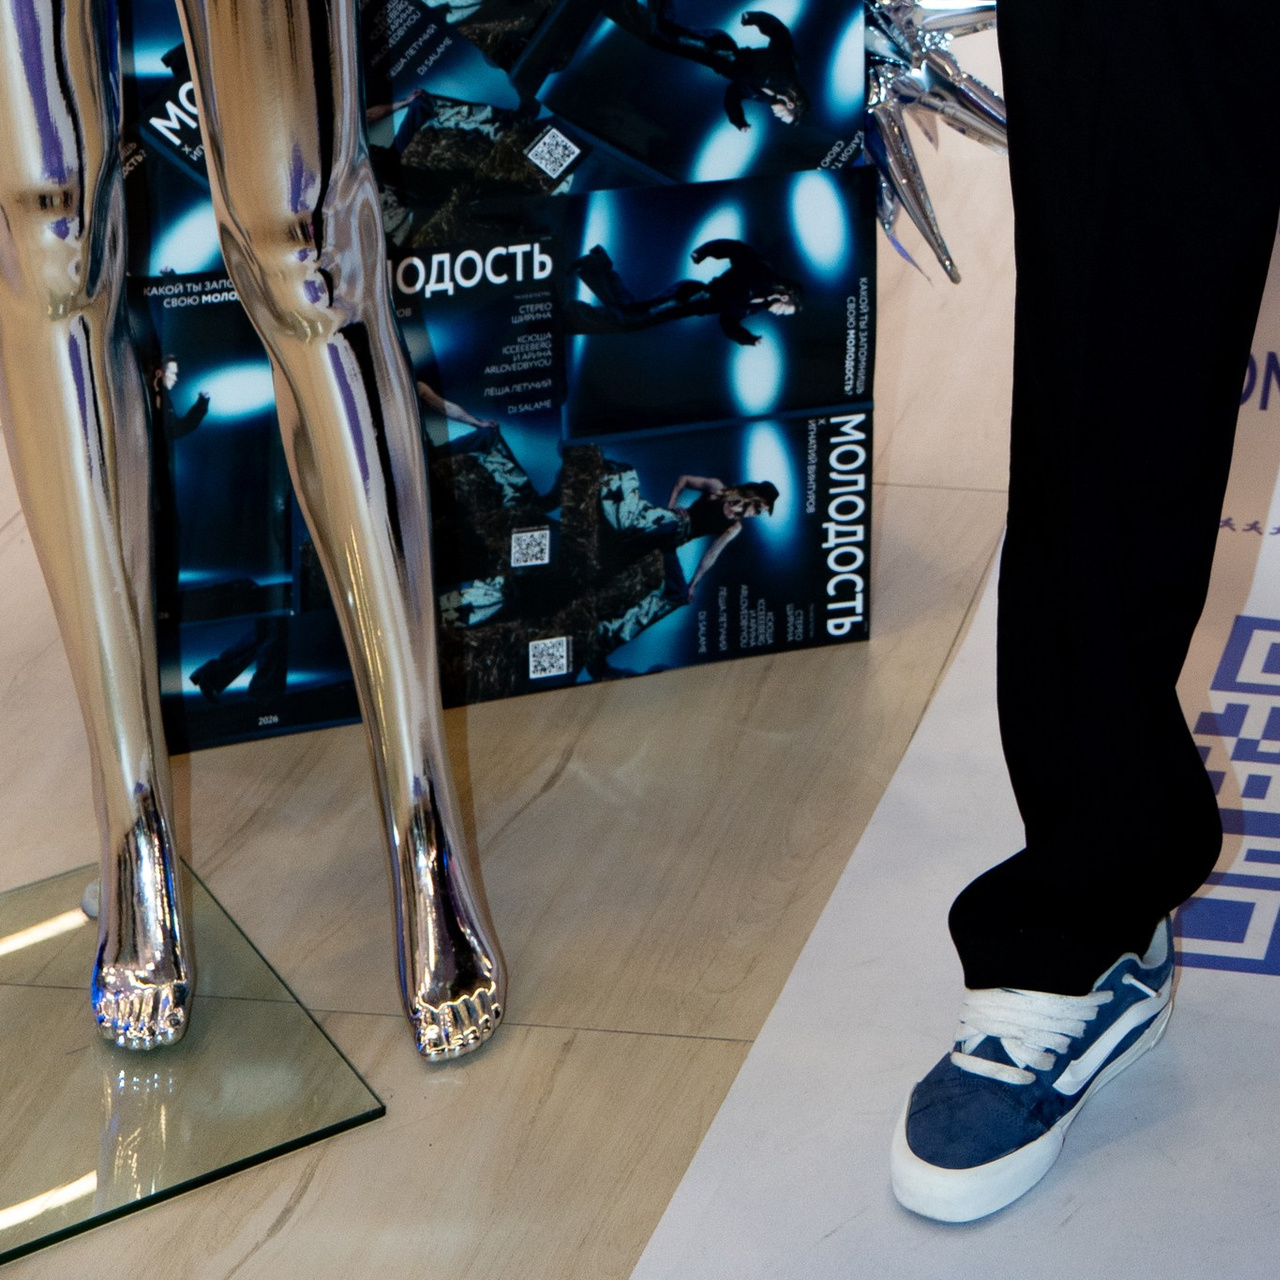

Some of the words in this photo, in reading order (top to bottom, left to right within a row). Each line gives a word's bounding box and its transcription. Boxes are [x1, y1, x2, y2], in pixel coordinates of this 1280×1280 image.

[387, 243, 553, 298] ОДОСТЬ
[143, 283, 183, 296] КАКОЙ
[186, 282, 201, 292] ТЫ
[163, 295, 199, 308] СВОЮ
[201, 291, 240, 304] МОЛО
[822, 413, 867, 636] МОЛОДОСТЬ
